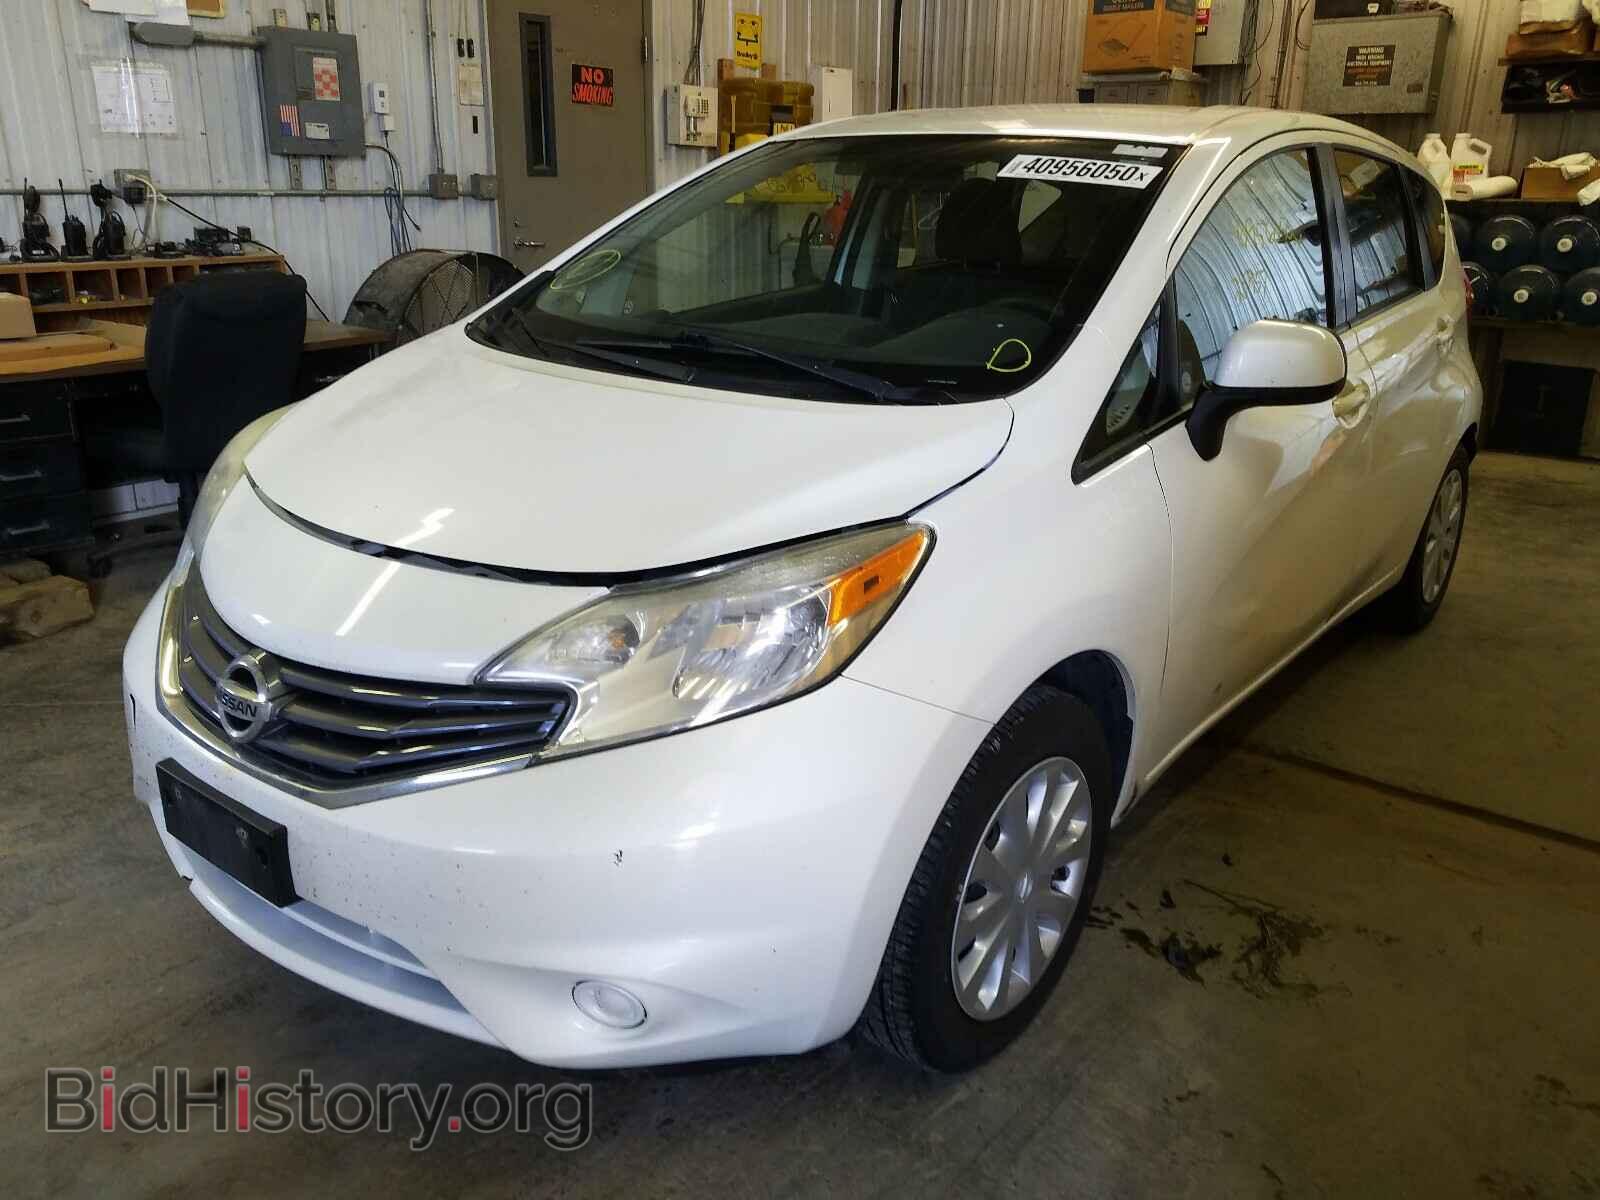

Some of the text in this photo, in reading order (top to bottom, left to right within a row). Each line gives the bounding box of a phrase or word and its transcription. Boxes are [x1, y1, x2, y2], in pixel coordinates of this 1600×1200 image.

[581, 66, 605, 85] NO
[573, 83, 614, 105] SMOKING
[1023, 157, 1140, 181] 40956050
